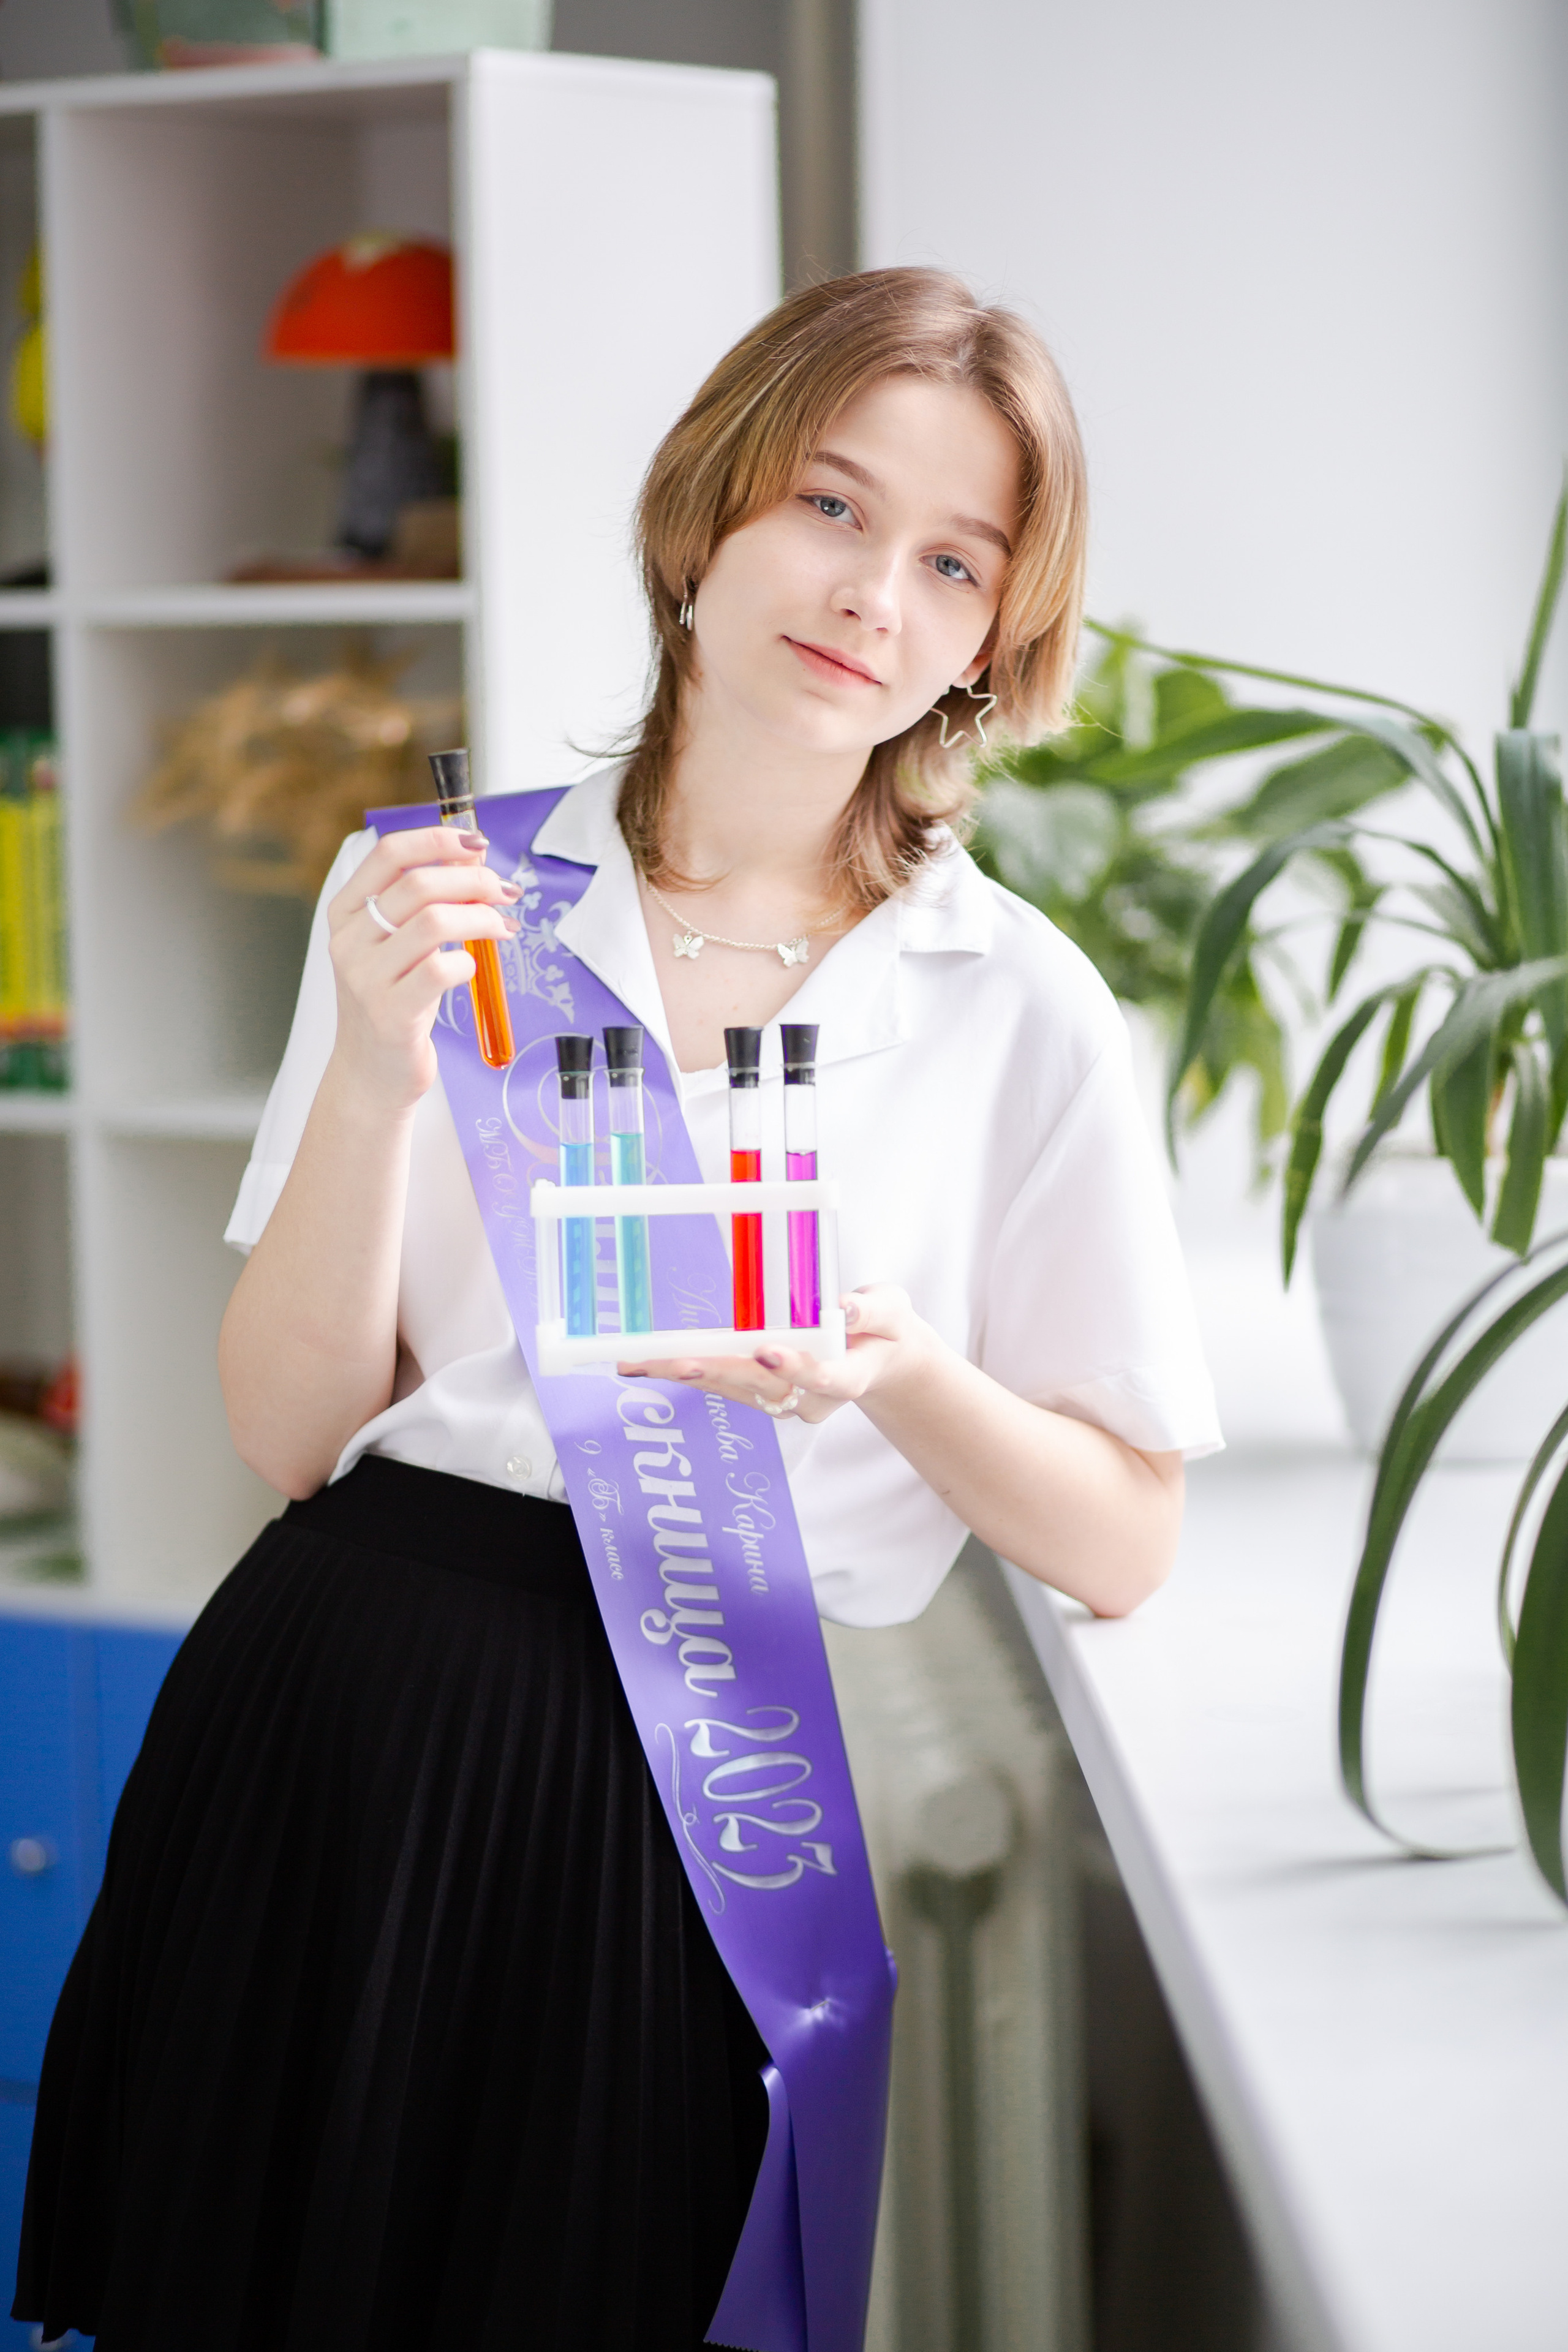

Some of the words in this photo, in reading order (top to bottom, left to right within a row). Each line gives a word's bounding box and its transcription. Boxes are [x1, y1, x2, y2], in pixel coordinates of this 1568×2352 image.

[575, 1439, 602, 1455] 9
[600, 1528, 624, 1581] класс
[723, 1471, 775, 1594] Карина
[684, 1705, 837, 1891] 2023
